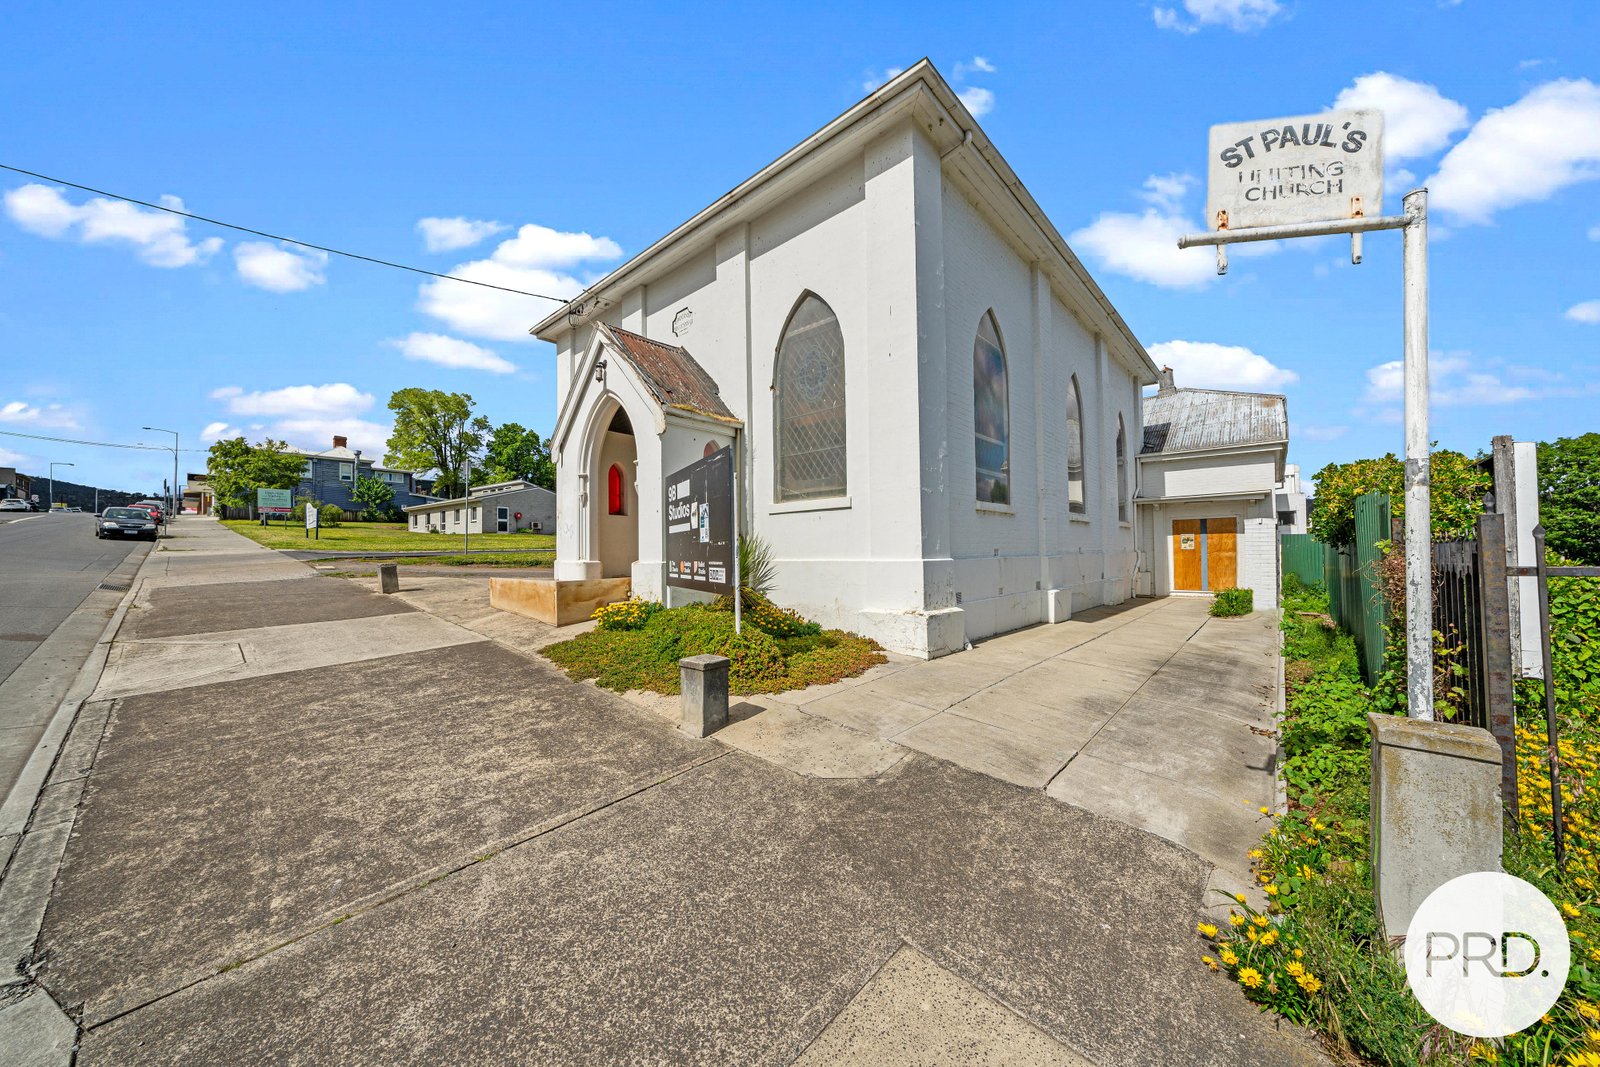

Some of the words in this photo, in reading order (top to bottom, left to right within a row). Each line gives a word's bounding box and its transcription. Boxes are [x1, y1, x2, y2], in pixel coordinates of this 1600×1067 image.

[1220, 136, 1256, 168] ST
[1260, 122, 1367, 153] PAUL'S
[1245, 179, 1343, 201] CHURCH
[669, 502, 690, 520] Studios
